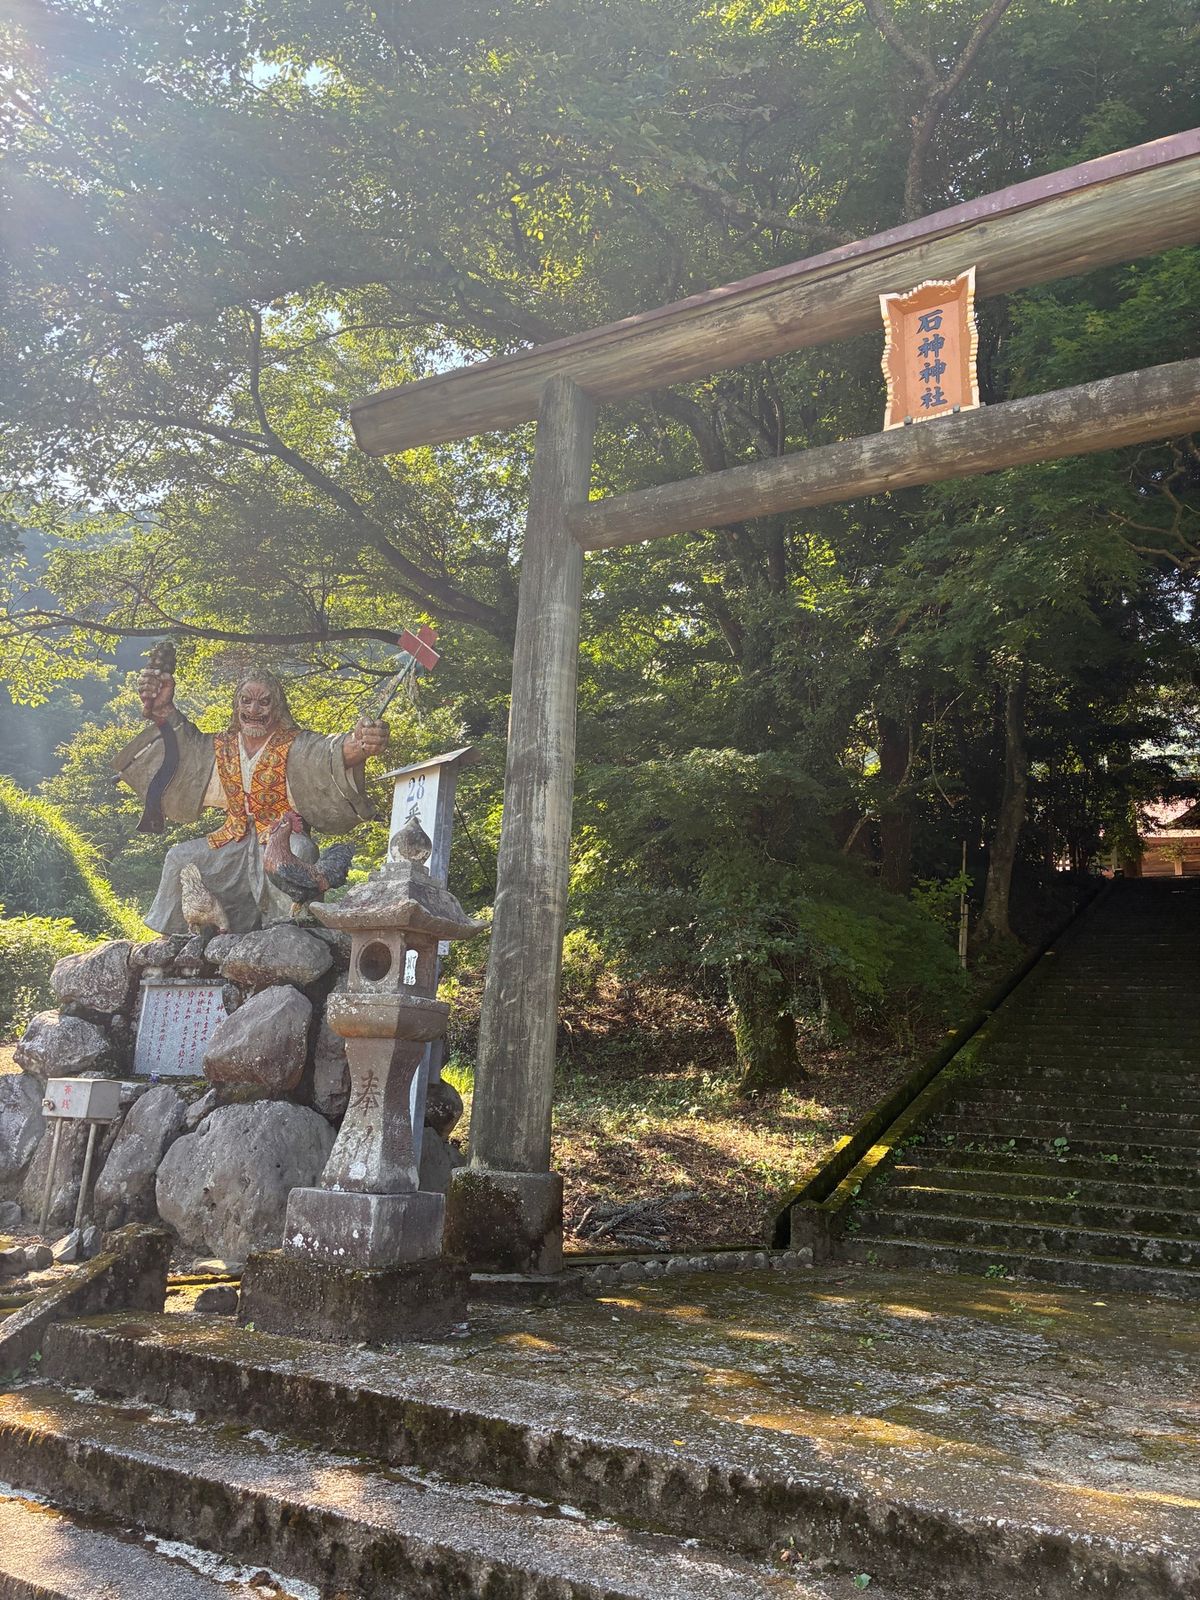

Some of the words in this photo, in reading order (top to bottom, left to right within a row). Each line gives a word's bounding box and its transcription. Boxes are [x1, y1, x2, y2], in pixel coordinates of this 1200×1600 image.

[916, 309, 948, 409] 石神神社
[406, 774, 426, 802] 28
